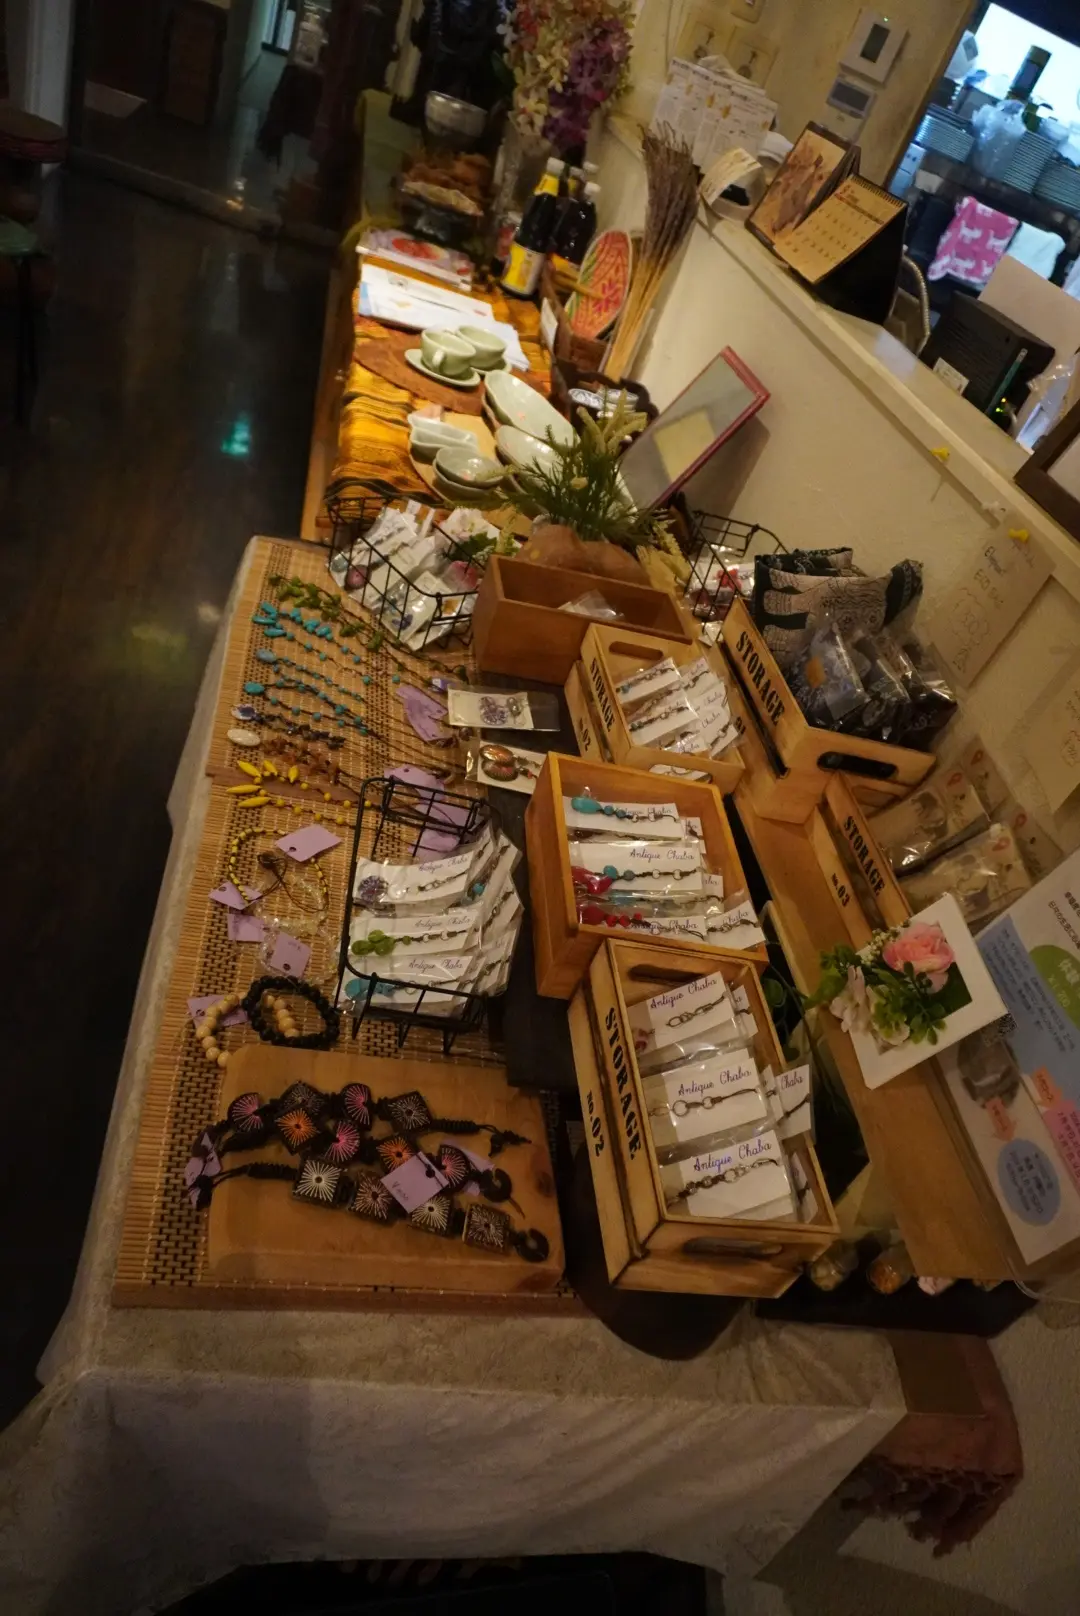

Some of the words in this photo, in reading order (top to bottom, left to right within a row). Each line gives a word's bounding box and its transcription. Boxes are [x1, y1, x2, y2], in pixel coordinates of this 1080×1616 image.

[735, 630, 786, 726] STORAGE
[590, 658, 615, 733] STORAGE
[629, 848, 661, 863] Antique
[666, 848, 695, 860] Chaba
[843, 815, 886, 897] STORAGE
[668, 918, 699, 931] Chaba
[650, 990, 684, 1010] Antique
[687, 976, 718, 995] Chaba
[604, 1007, 643, 1161] STORAGE
[678, 1079, 715, 1098] Antique
[719, 1066, 752, 1085] Chaba
[780, 1071, 804, 1091] Chaba
[693, 1153, 733, 1173] Antique
[737, 1140, 772, 1160] Chaba
